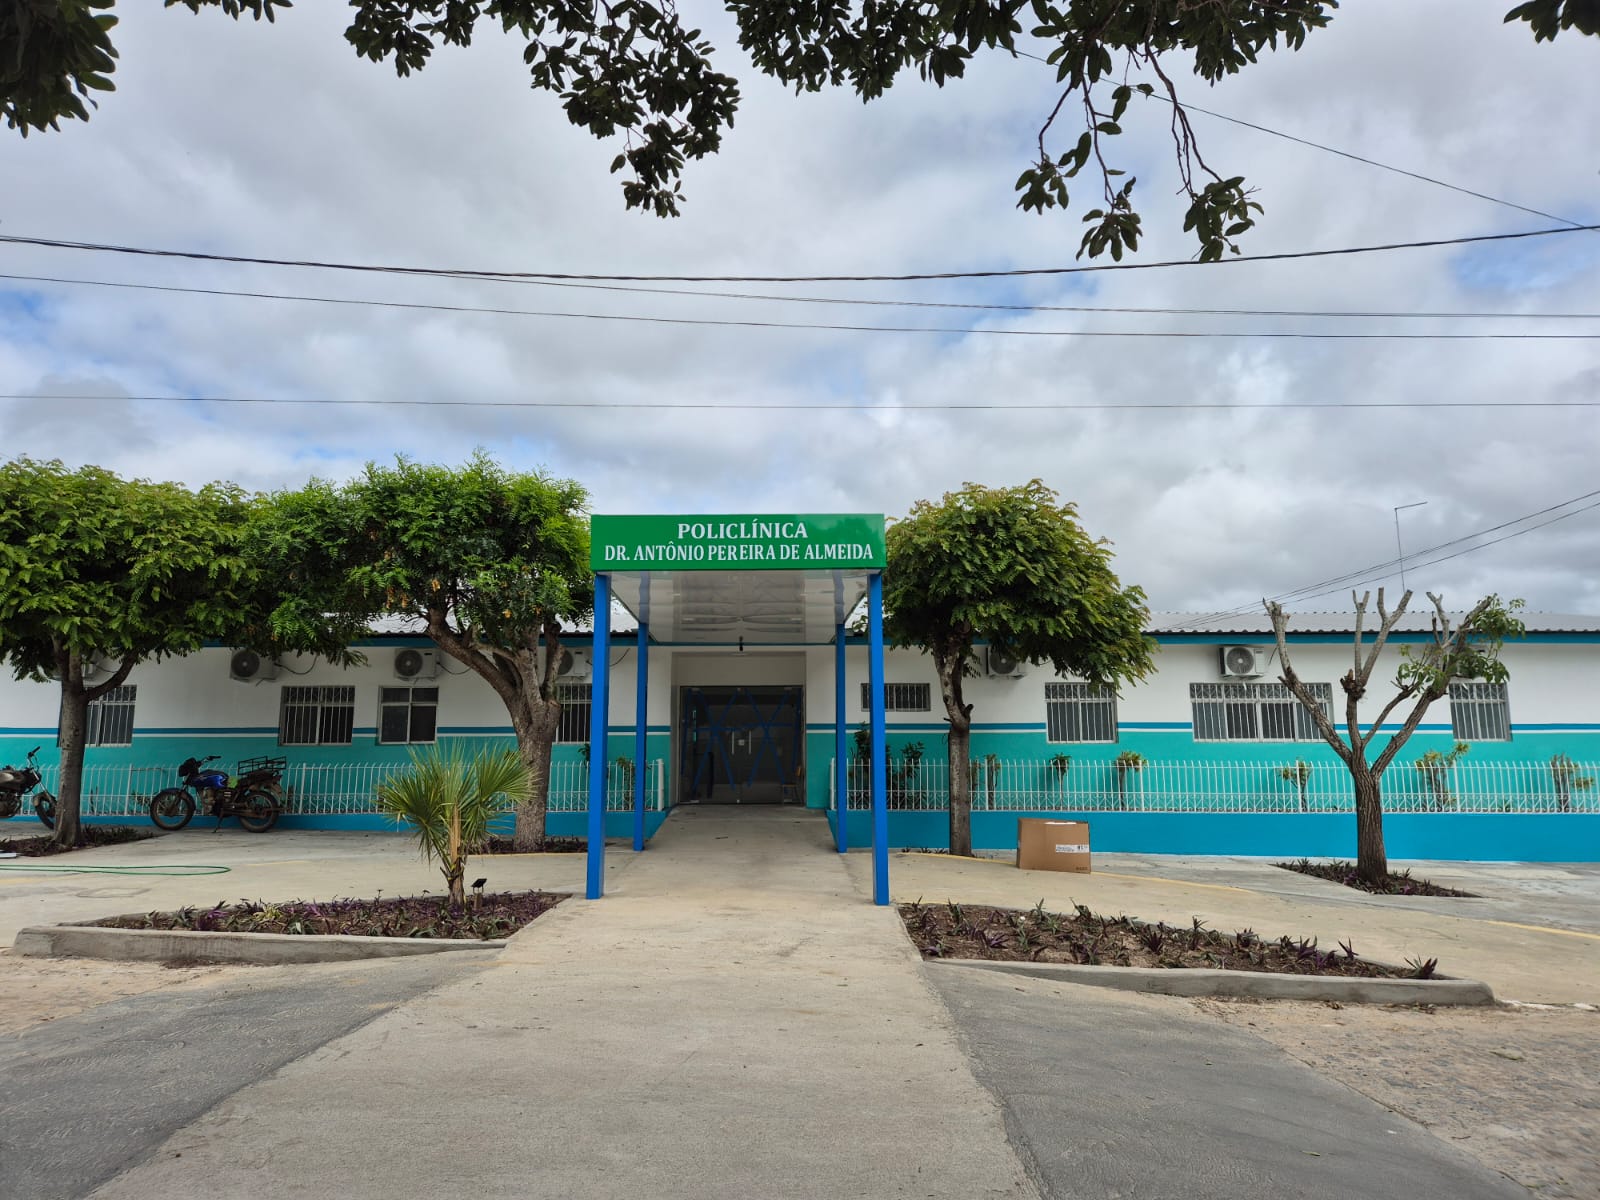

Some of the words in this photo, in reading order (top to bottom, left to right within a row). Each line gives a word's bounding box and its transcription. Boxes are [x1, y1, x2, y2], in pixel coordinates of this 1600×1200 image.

[677, 518, 808, 539] POLICLÍNICA
[604, 544, 630, 561] DR.
[634, 541, 705, 561] ANTÔNIO
[708, 544, 776, 561] PEREIRA
[780, 544, 800, 560] DE
[804, 543, 873, 560] ALMEIDA
